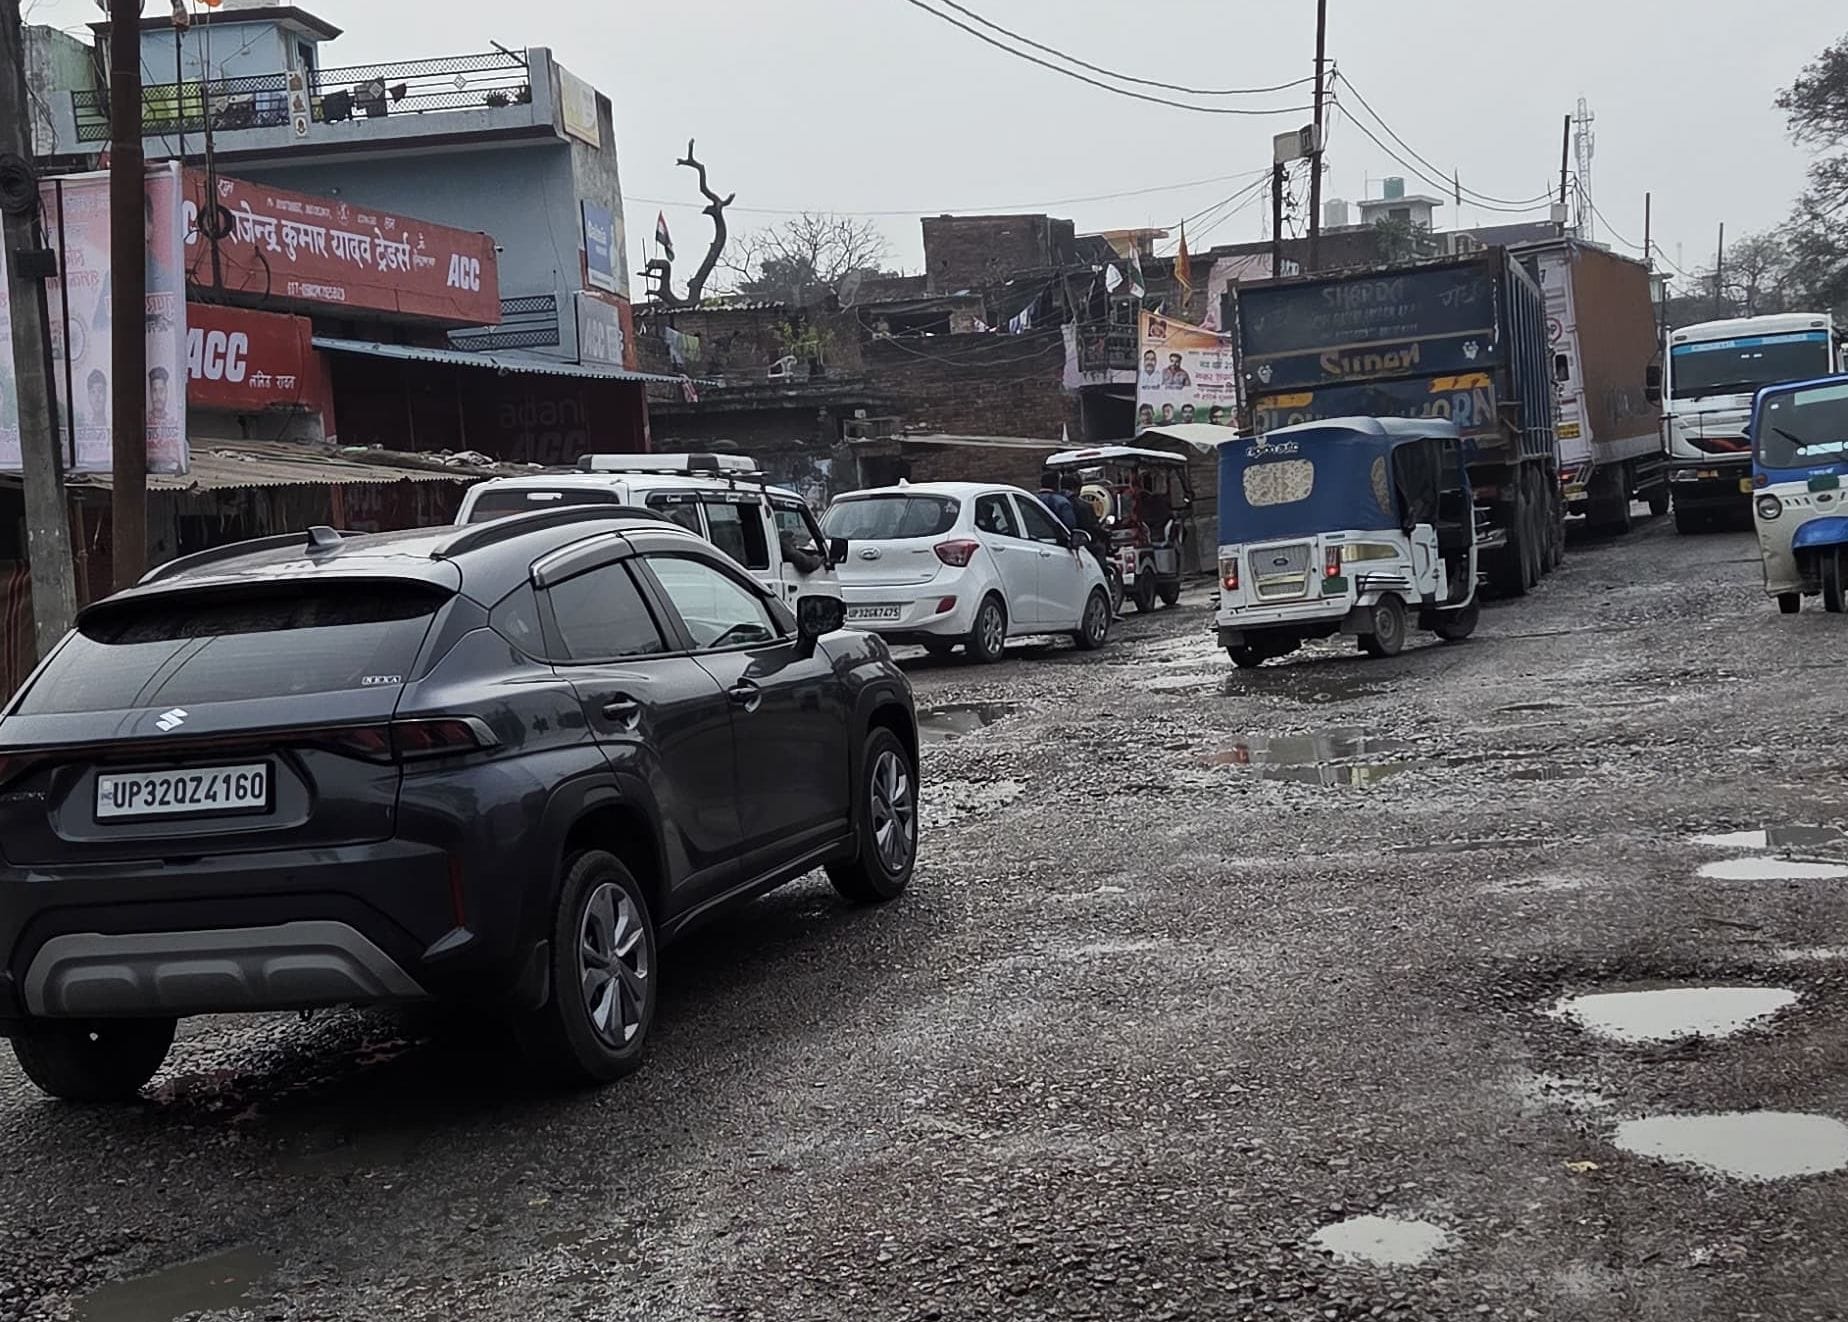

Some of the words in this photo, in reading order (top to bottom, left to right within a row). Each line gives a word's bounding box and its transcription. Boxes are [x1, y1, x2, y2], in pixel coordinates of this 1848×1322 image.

[281, 218, 328, 262] कुमार
[330, 229, 371, 270] यादव
[374, 226, 410, 272] ट्रेडर्स
[446, 253, 481, 292] ACC
[186, 328, 248, 382] ACC
[500, 390, 586, 429] adani
[113, 772, 265, 808] UP32QZ4160
